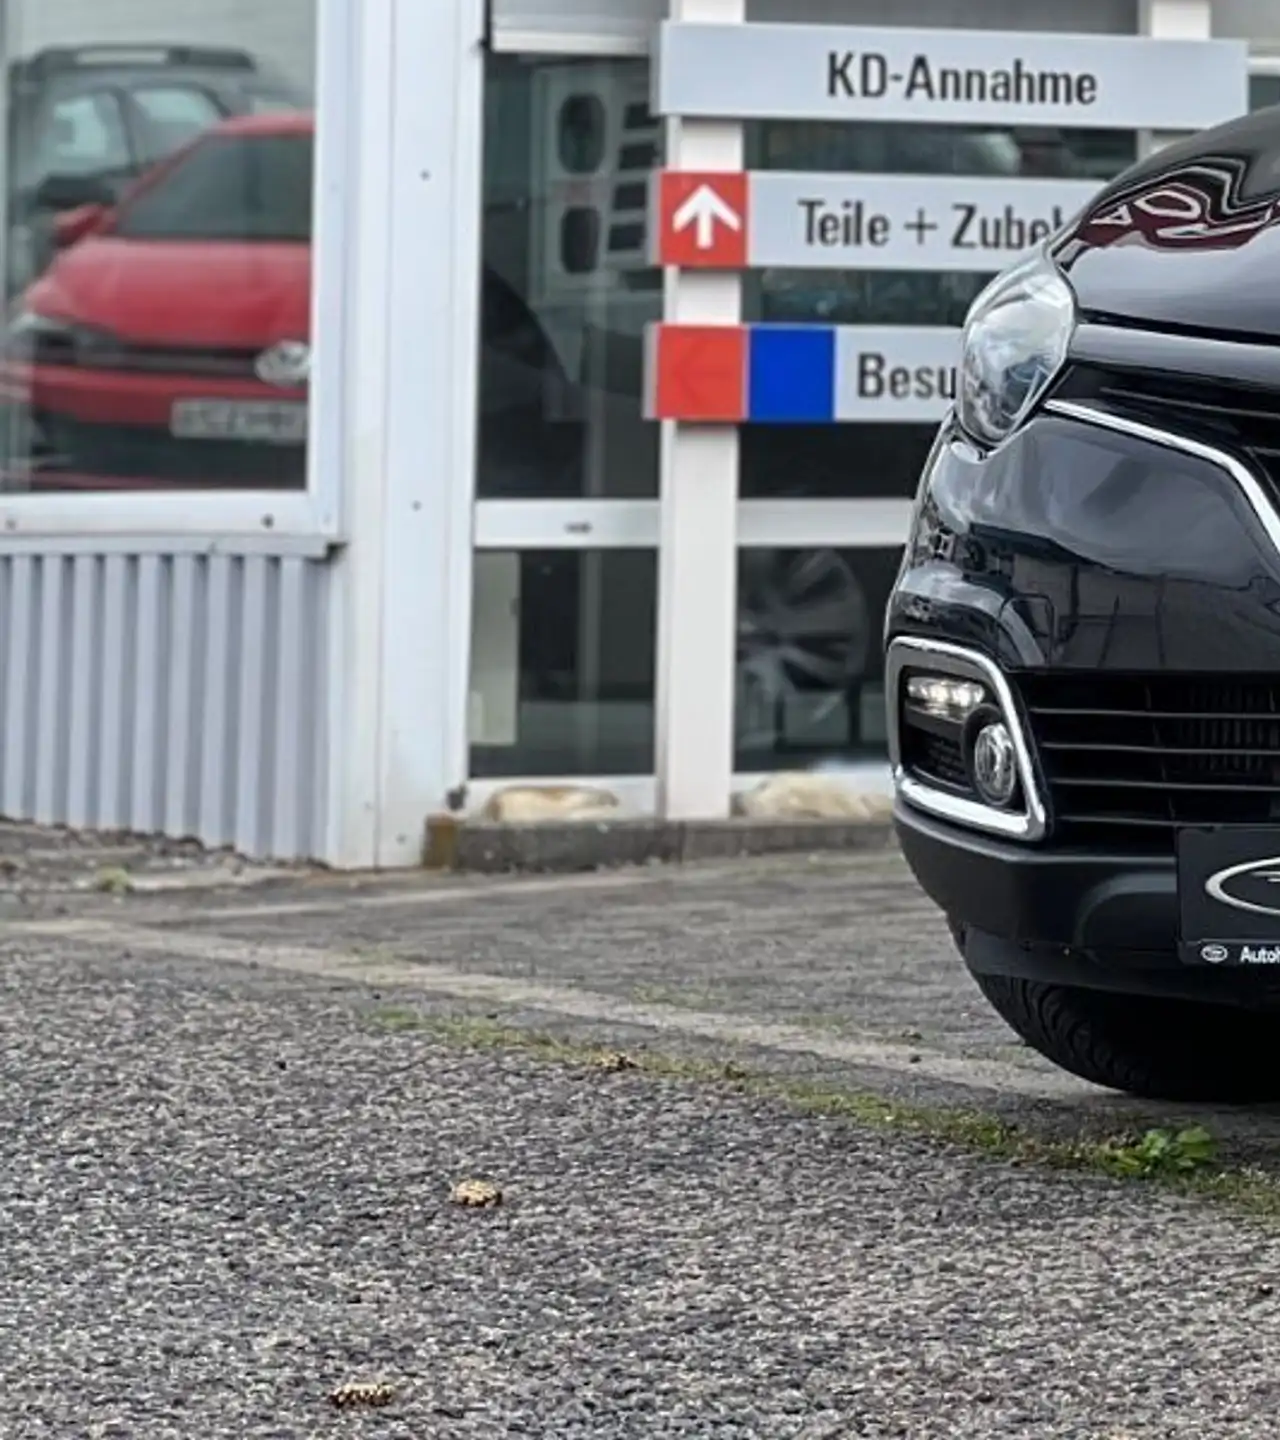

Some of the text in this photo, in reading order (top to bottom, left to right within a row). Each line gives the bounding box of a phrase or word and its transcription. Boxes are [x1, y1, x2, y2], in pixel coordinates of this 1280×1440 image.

[827, 51, 1098, 106] KD-Annahme
[798, 199, 1063, 249] Teile + Zube
[857, 352, 957, 400] Besu
